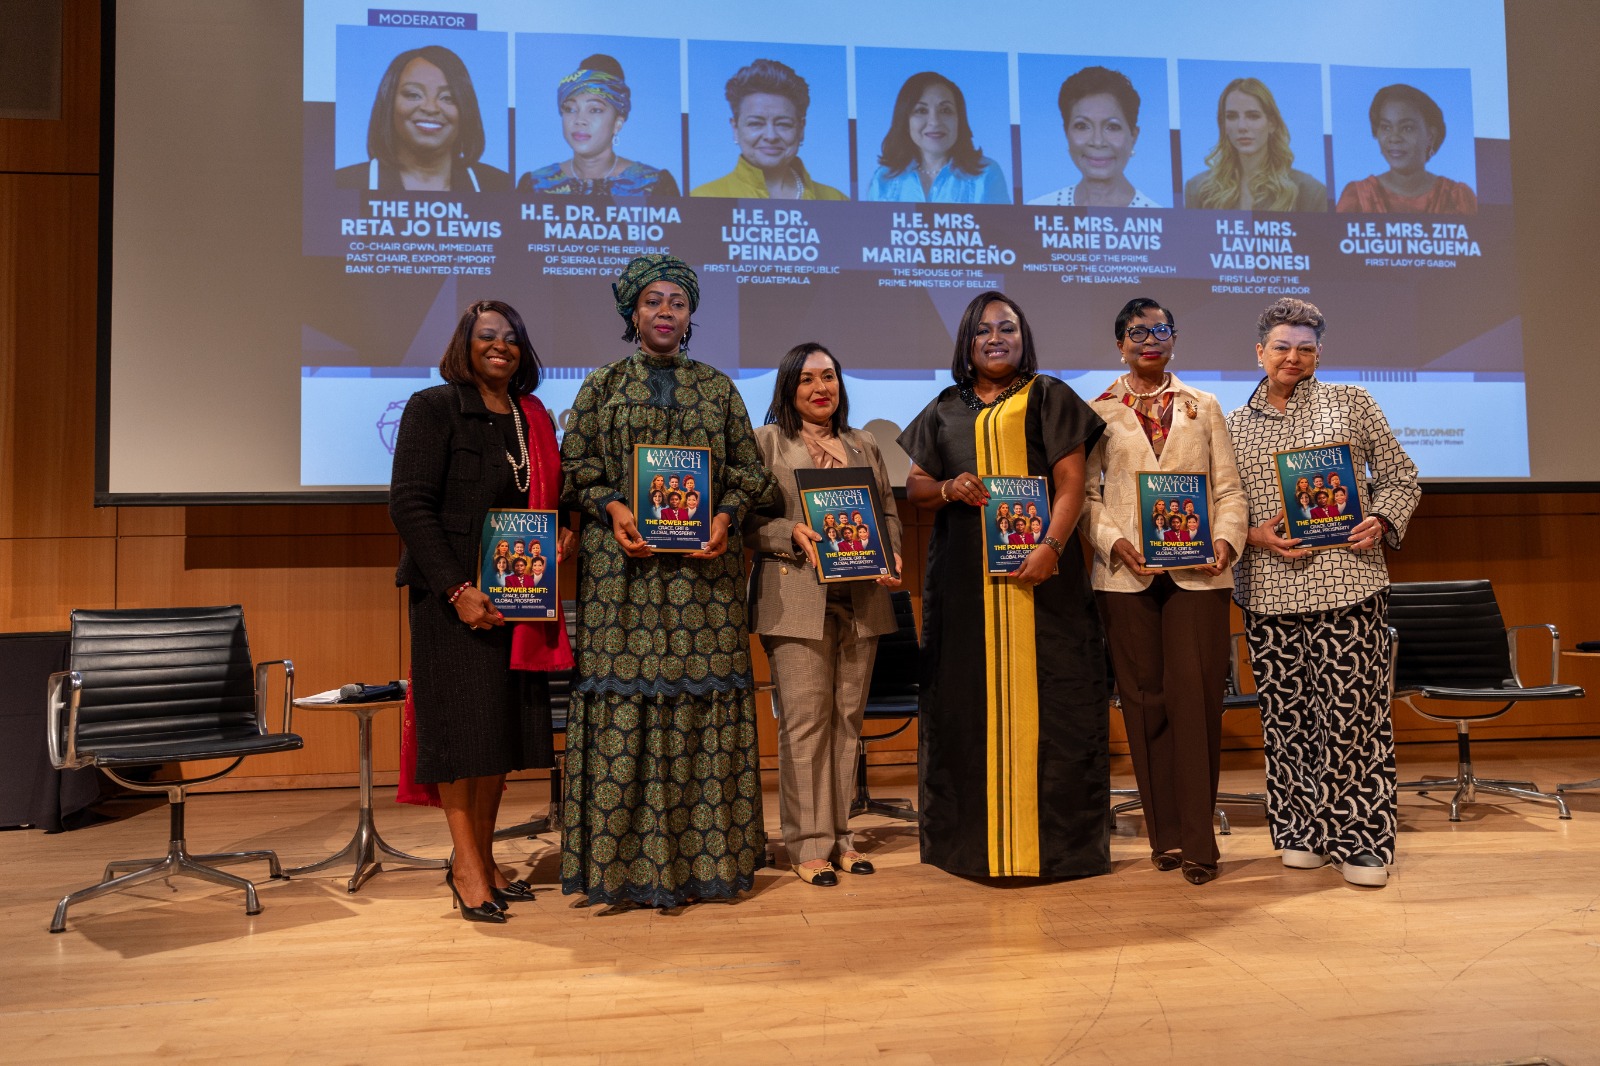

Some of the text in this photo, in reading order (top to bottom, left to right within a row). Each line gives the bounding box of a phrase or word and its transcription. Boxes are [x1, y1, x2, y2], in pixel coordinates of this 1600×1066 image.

[379, 13, 465, 27] MODERATOR
[369, 201, 469, 219] THE HON.
[521, 204, 681, 223] H.E. DR. FATIMA
[733, 209, 808, 226] H.E. DR.
[893, 212, 980, 230] H.E. MRS.
[342, 219, 502, 238] RETA JO LEWIS
[1034, 215, 1162, 233] H.E. MRS. ANN
[1216, 220, 1296, 236] H.E. MRS.
[545, 223, 663, 241] MAADA BIO
[722, 226, 820, 244] LUCRECIA
[1347, 223, 1468, 239] H.E. MRS. ZITA
[891, 230, 983, 247] ROSSANA
[1042, 233, 1161, 250] MARIE DAVIS
[350, 242, 493, 252] CO-CHAIR GPWN, IMMEDIATE
[528, 244, 669, 255] FIRST LADY OF THE REPUBLIC
[1222, 237, 1292, 253] LAVINIA
[1340, 239, 1481, 256] OLIGUI NGUEMA
[729, 244, 818, 261] PEINADO
[862, 245, 1016, 265] MARIA BRICEÑO
[1051, 253, 1087, 261] SPOUSE
[1089, 254, 1101, 262] OF
[1103, 254, 1120, 262] THE
[347, 254, 496, 264] PAST CHAIR, EXPORT-IMPORT
[545, 255, 559, 264] OF
[561, 256, 596, 264] SIERRA
[1210, 253, 1310, 270] VALBONESI
[1414, 259, 1425, 267] OF
[346, 265, 491, 275] BANK OF THE UNITED STATES
[543, 267, 597, 275] PRESIDENT
[600, 268, 614, 276] OF
[704, 264, 840, 274] FIRST LADY OF THE REPUBLIC
[892, 268, 983, 277] THE SPOUSE OF THE
[1023, 264, 1063, 272] MINISTER
[1066, 264, 1078, 272] OF
[1099, 265, 1176, 273] COMMONWEALTH
[736, 276, 810, 285] OF GUATEMALA
[879, 279, 906, 287] PRIME
[909, 279, 951, 288] MINISTER
[953, 280, 965, 288] OF
[1062, 275, 1075, 283] OF
[1076, 275, 1092, 283] THE
[1220, 275, 1243, 283] FIRST
[1269, 276, 1281, 284] OF
[1282, 276, 1299, 284] THE
[1212, 285, 1310, 294] REPUBLIC OF ECUADOR
[652, 450, 701, 458] AMAZONS
[1292, 448, 1341, 460] AMAZONS
[651, 456, 701, 468] WATCH
[1292, 454, 1343, 470] WATCH
[995, 486, 1040, 496] WATCH
[1152, 482, 1199, 492] WATCH
[819, 490, 861, 498] AMAZONS
[820, 494, 864, 507] WATCH
[496, 520, 548, 532] WATCH
